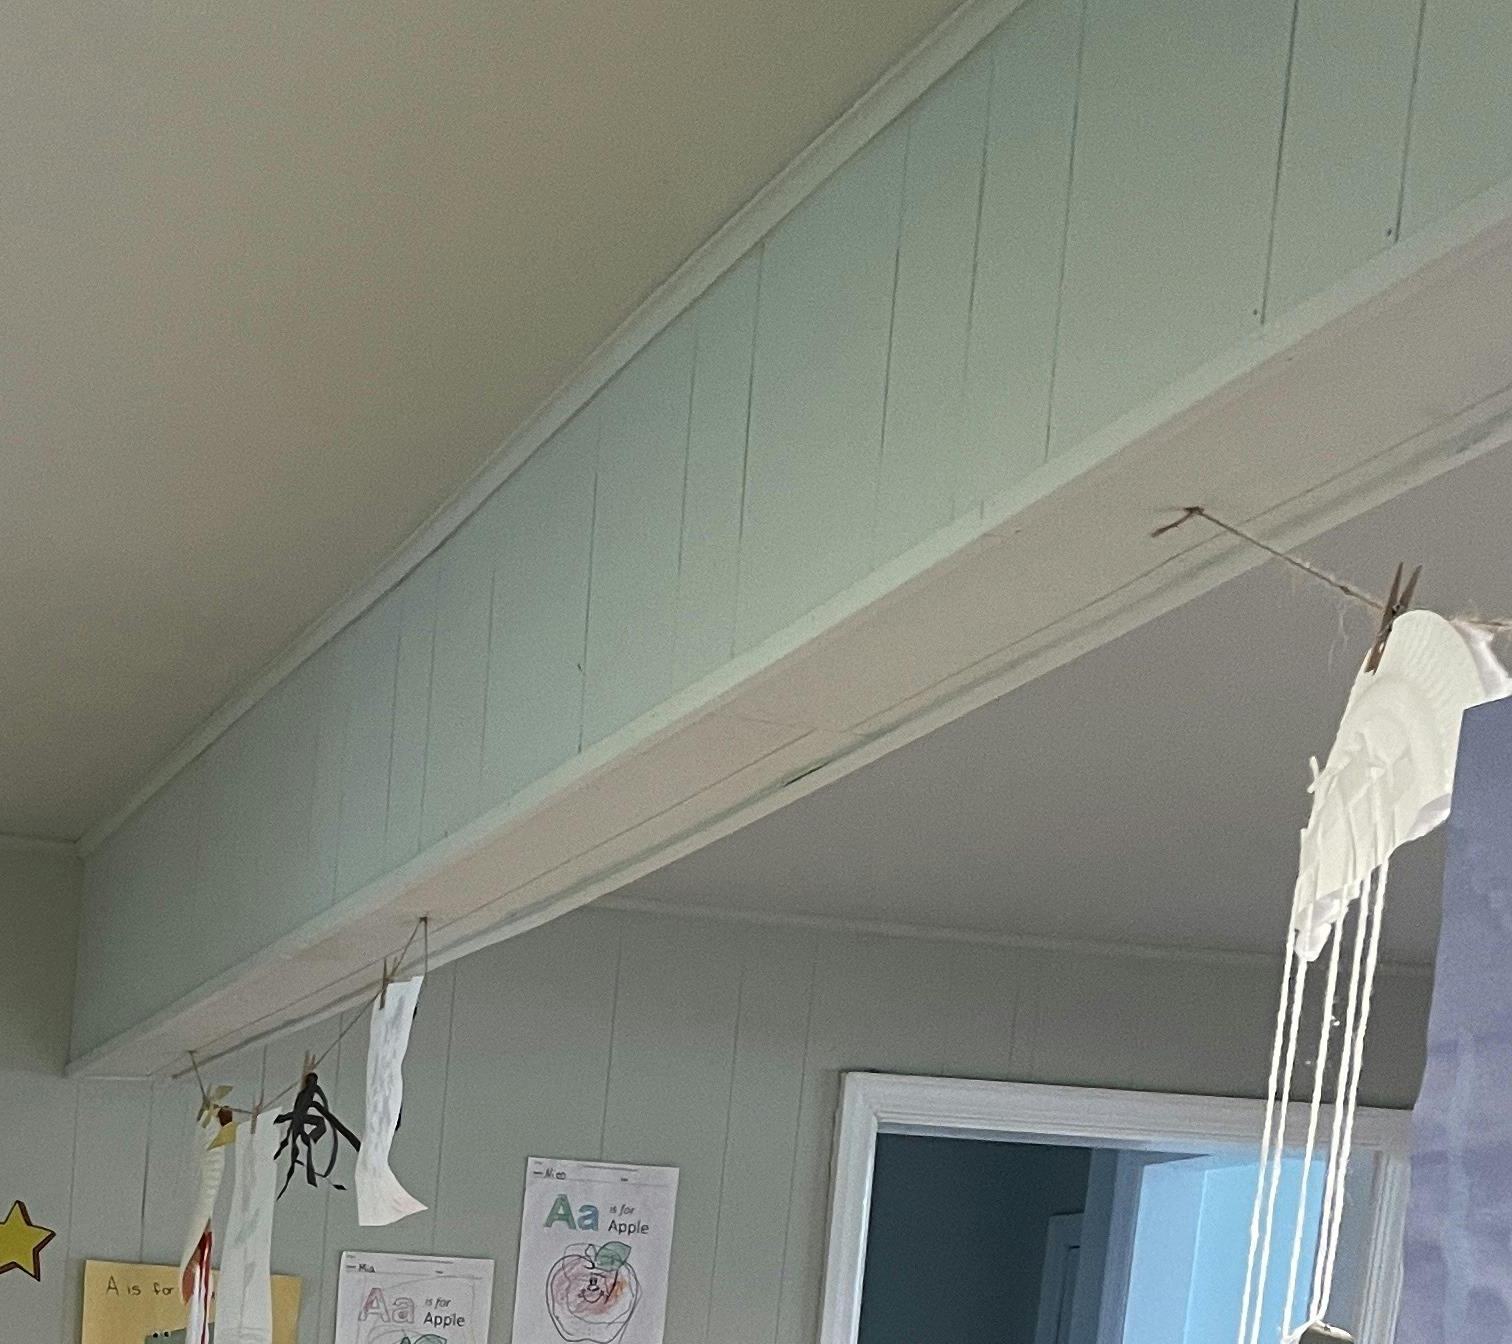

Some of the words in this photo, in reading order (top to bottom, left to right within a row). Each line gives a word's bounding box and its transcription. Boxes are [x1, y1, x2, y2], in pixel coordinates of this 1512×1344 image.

[543, 1194, 599, 1231] Aa
[610, 1205, 617, 1213] is
[619, 1204, 635, 1216] for
[608, 1220, 649, 1235] Apple
[106, 1276, 119, 1296] A
[128, 1285, 141, 1295] is
[153, 1282, 174, 1295] for
[358, 1288, 415, 1324] Aa
[435, 1298, 452, 1309] for
[423, 1312, 465, 1328] Apple
